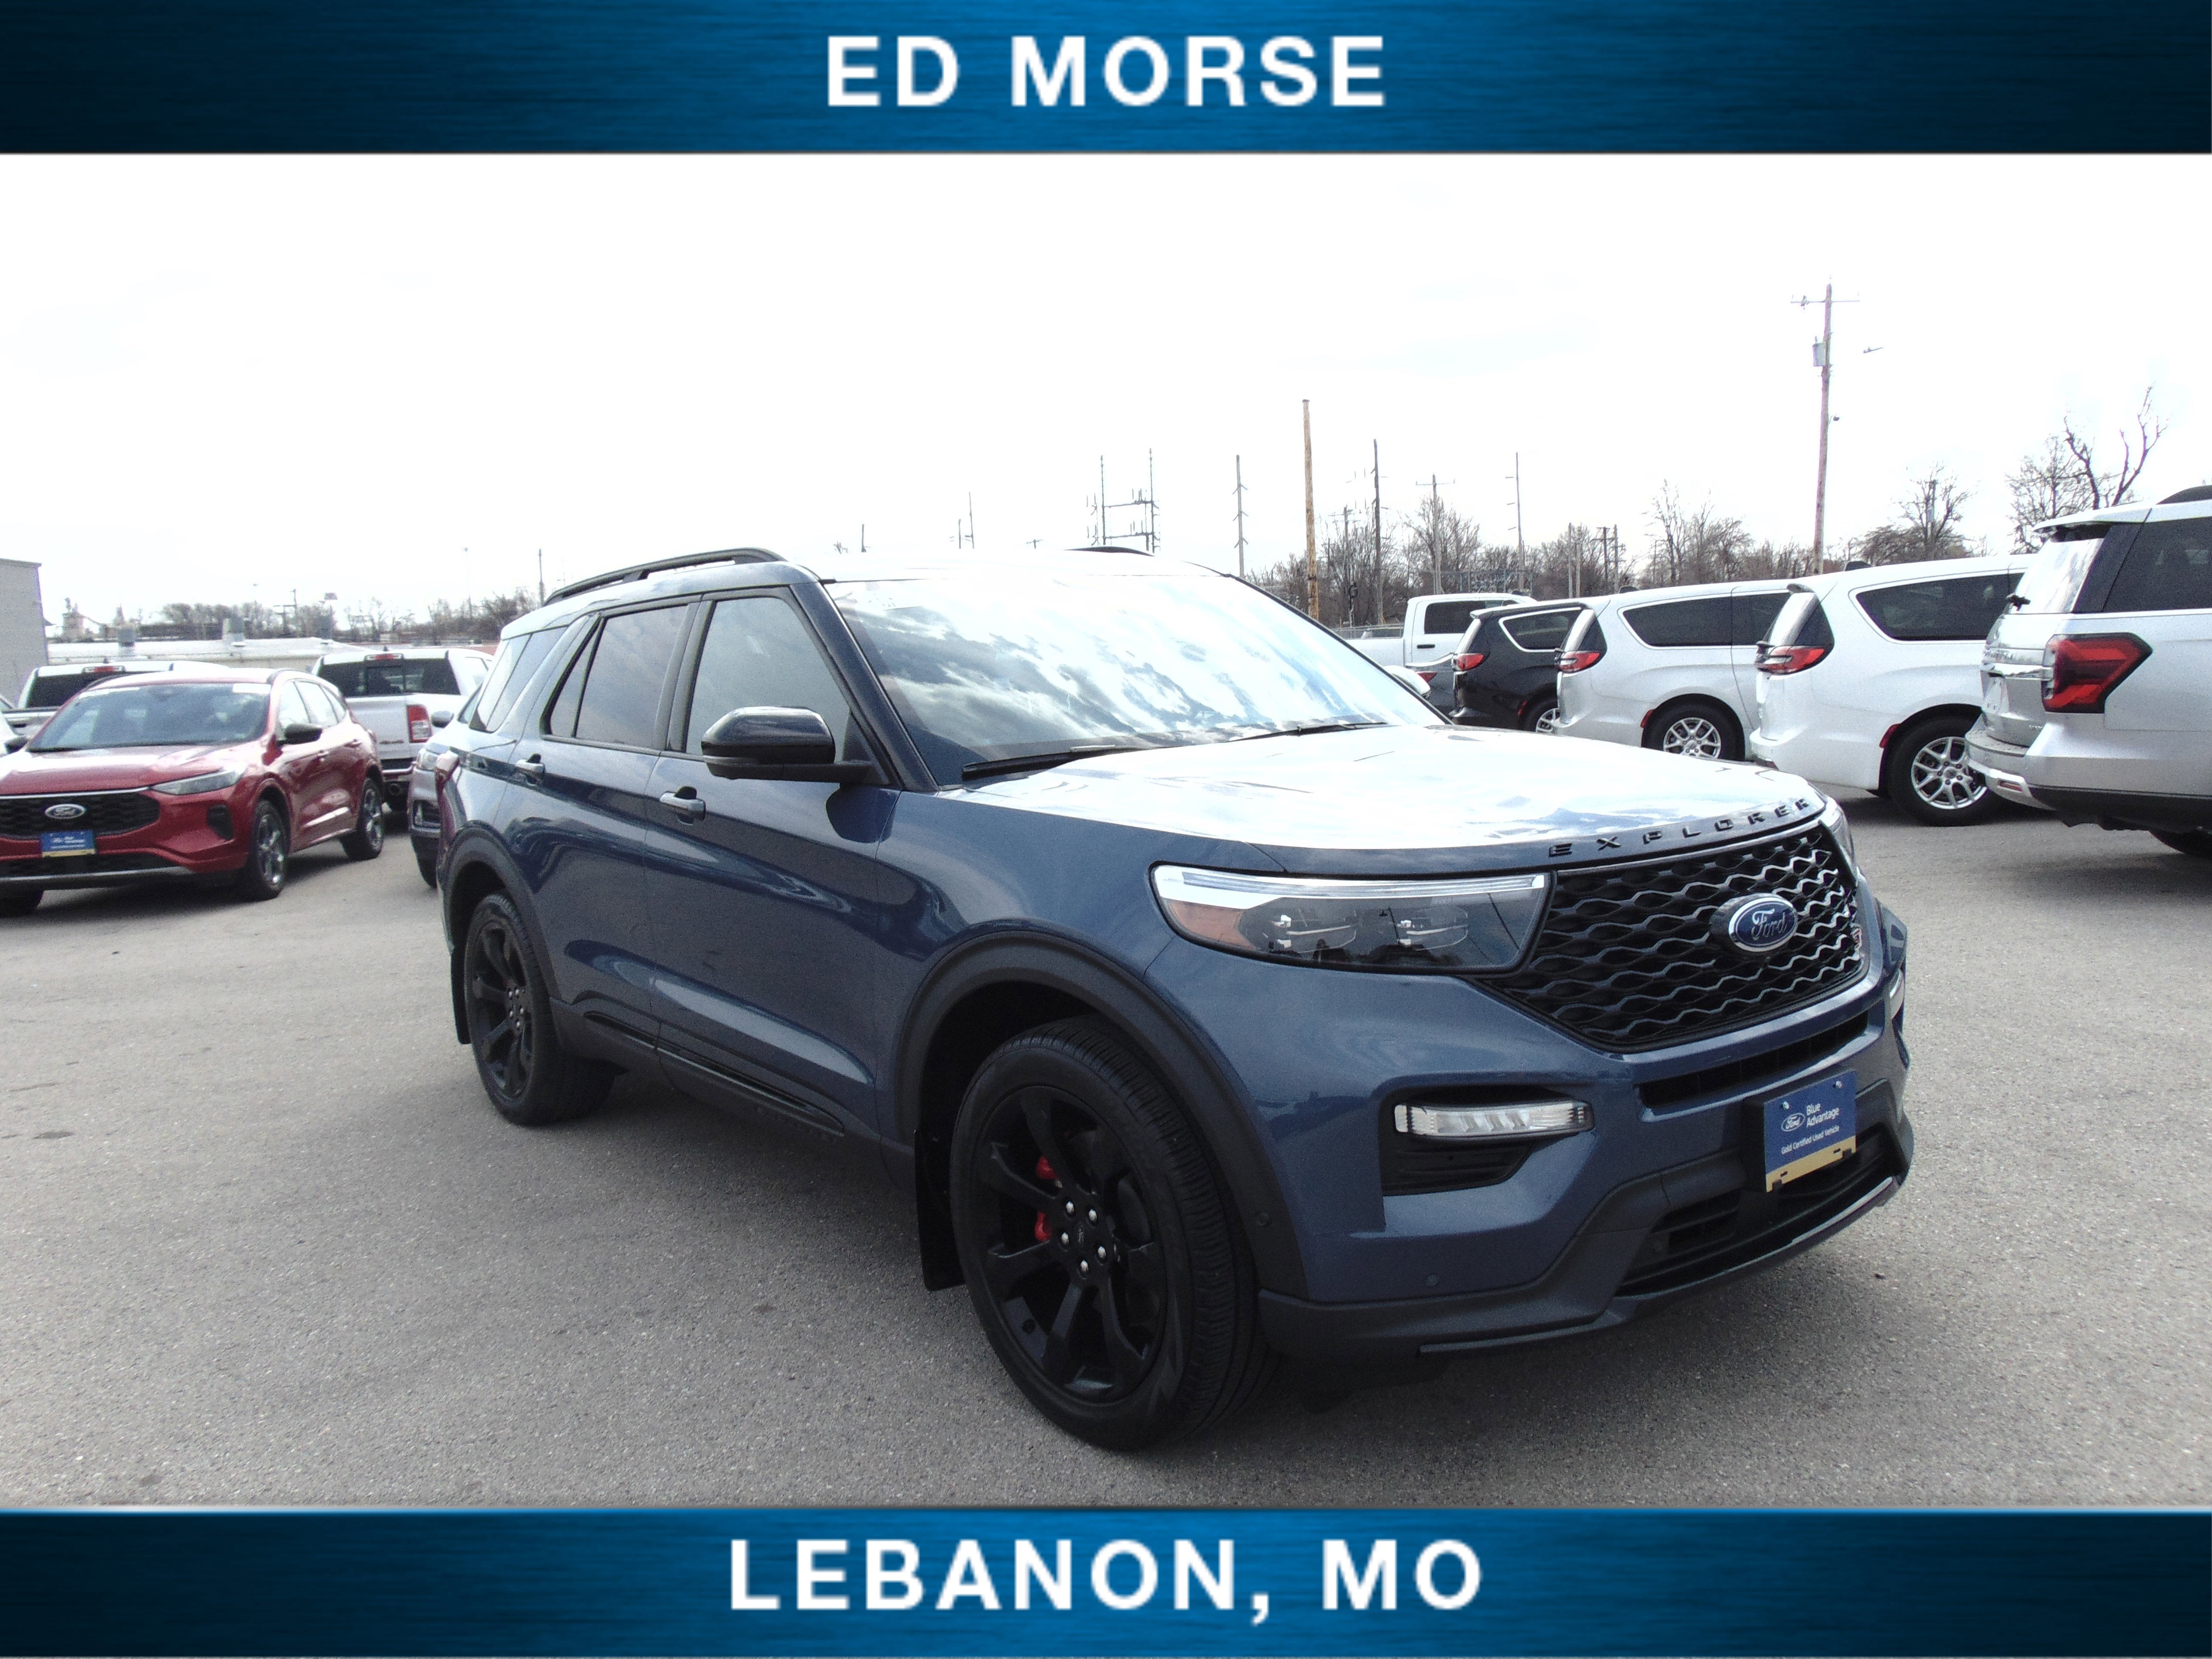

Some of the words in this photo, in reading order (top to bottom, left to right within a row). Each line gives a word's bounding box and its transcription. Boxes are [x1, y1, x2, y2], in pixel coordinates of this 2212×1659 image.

[1549, 798, 1809, 857] EXPLORER
[1751, 908, 1787, 941] Ford
[1806, 1103, 1821, 1116] Blue
[1806, 1108, 1839, 1128] Advantage
[1786, 1115, 1801, 1130] Ford
[1781, 1143, 1793, 1155] Gold
[1793, 1136, 1812, 1149] Certified
[1812, 1130, 1824, 1141] Used
[1825, 1125, 1839, 1136] Vehicle
